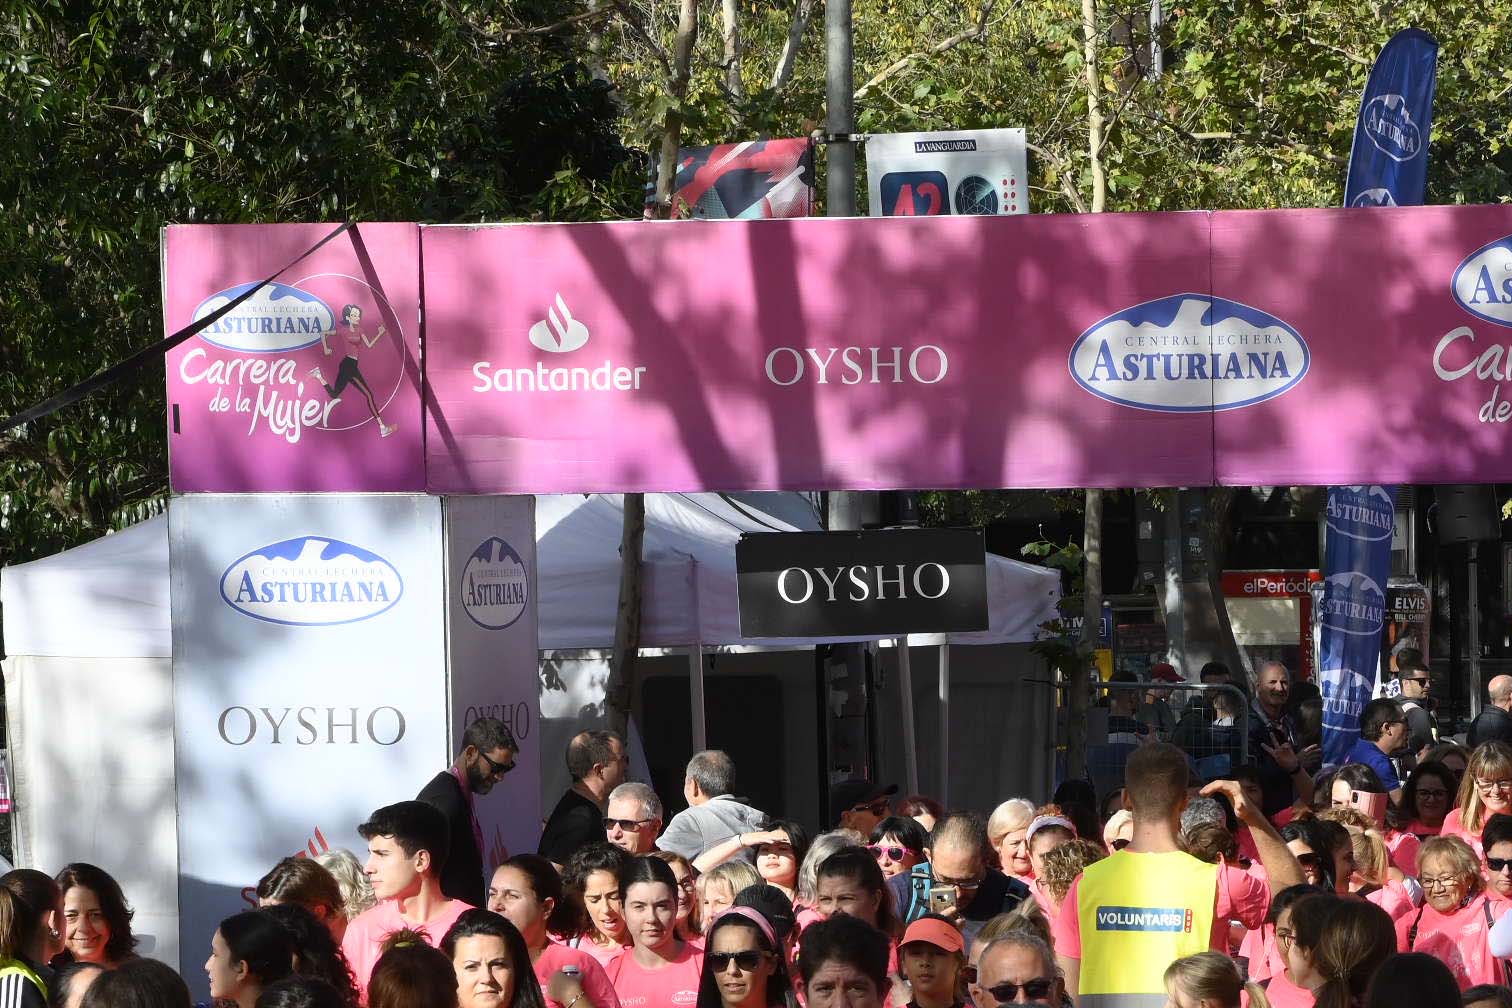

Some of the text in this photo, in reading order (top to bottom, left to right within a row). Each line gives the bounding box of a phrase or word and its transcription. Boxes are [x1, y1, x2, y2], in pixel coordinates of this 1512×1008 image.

[925, 140, 976, 152] VANGUARDIA
[204, 308, 323, 334] ASTURIANA
[1125, 333, 1283, 347] CENTRAL LECHERA
[180, 347, 297, 386] Carrera
[472, 361, 646, 393] Santander
[764, 345, 949, 386] OYSHO
[1088, 338, 1291, 382] ASTURIANA
[209, 387, 251, 413] de la
[248, 382, 343, 444] Mujer
[1326, 493, 1392, 530] ASTURIANA
[234, 570, 390, 603] ASTURIANA
[466, 573, 525, 608] ASTURIANA
[776, 561, 950, 605] OYSHO
[1395, 597, 1425, 609] ELVIS
[217, 706, 406, 746] OYSHO
[1099, 912, 1182, 927] VOLUNTARIS
